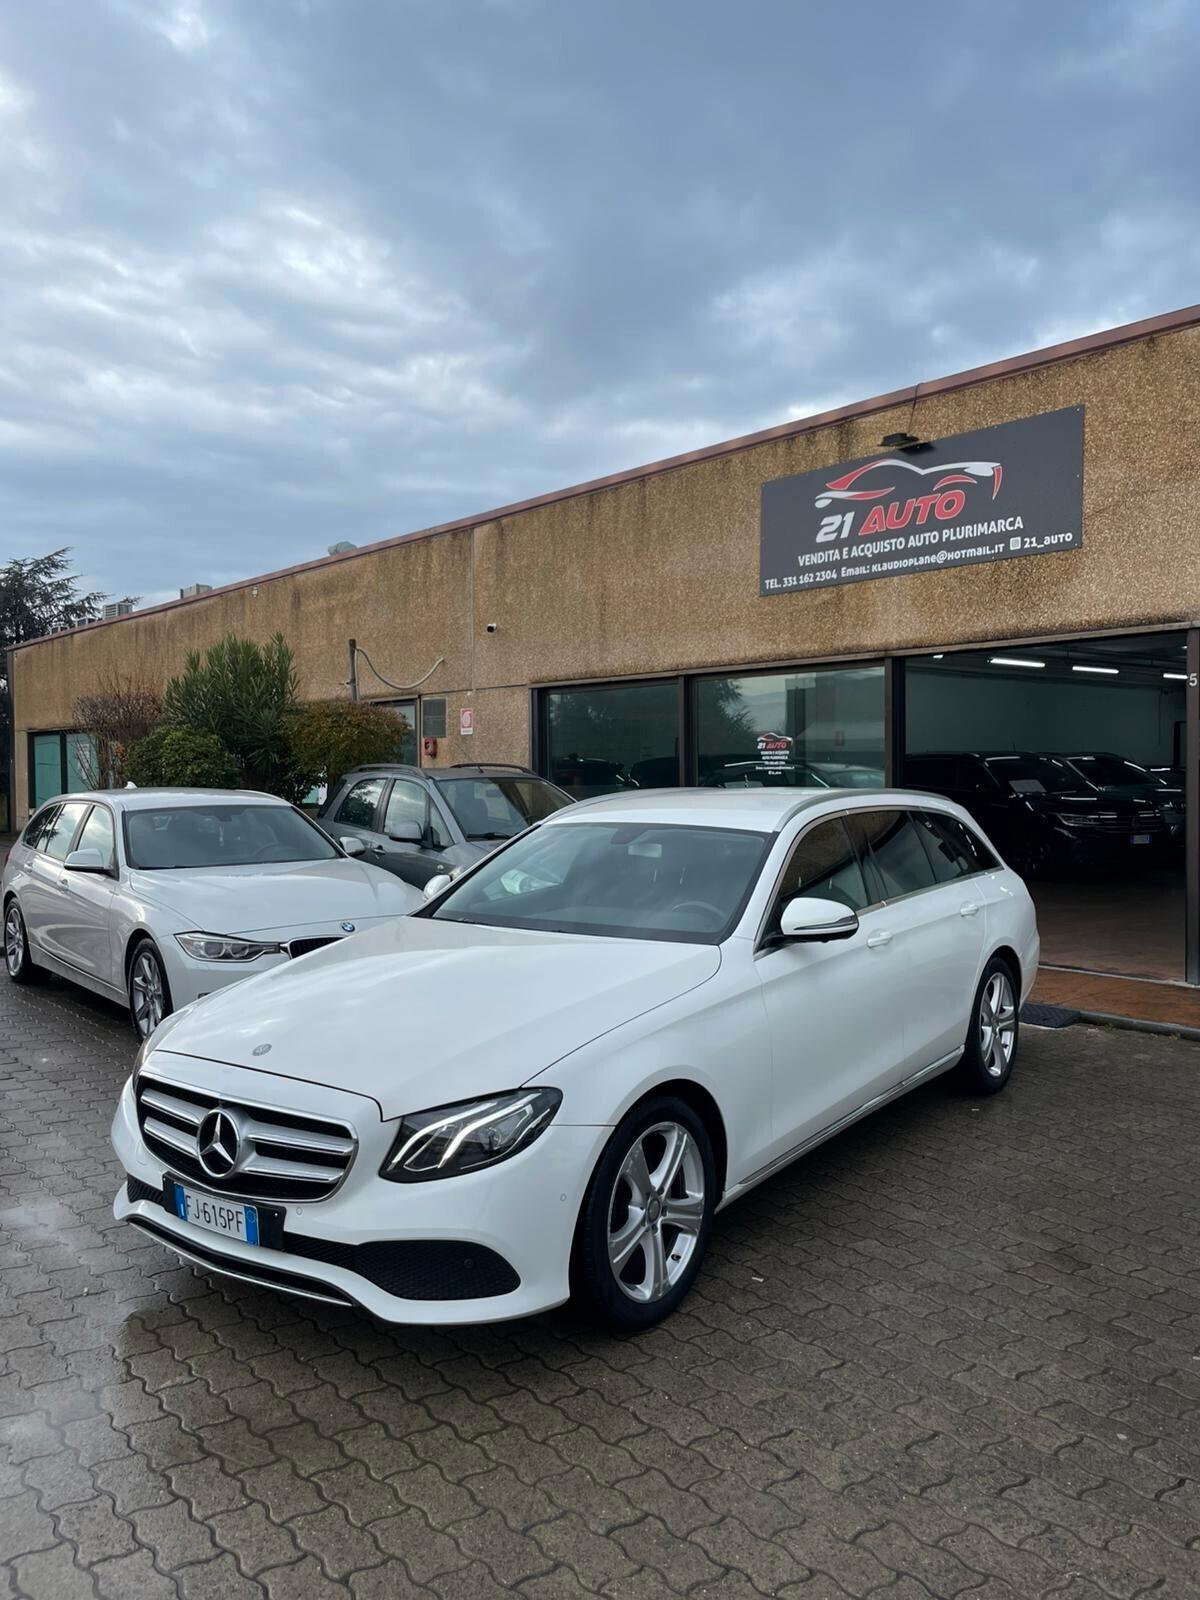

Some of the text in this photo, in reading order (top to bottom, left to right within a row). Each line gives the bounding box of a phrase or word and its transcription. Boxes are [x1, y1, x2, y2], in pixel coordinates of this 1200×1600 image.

[816, 489, 966, 543] 21 AUTO
[798, 516, 1024, 567] VENDITA E ACQUISTO AUTO PLURIMARCA
[765, 578, 782, 590] TEL.
[782, 576, 797, 588] 331
[815, 569, 838, 582] 2304
[1189, 672, 1198, 687] 5
[185, 1194, 244, 1233] FJ615PF
